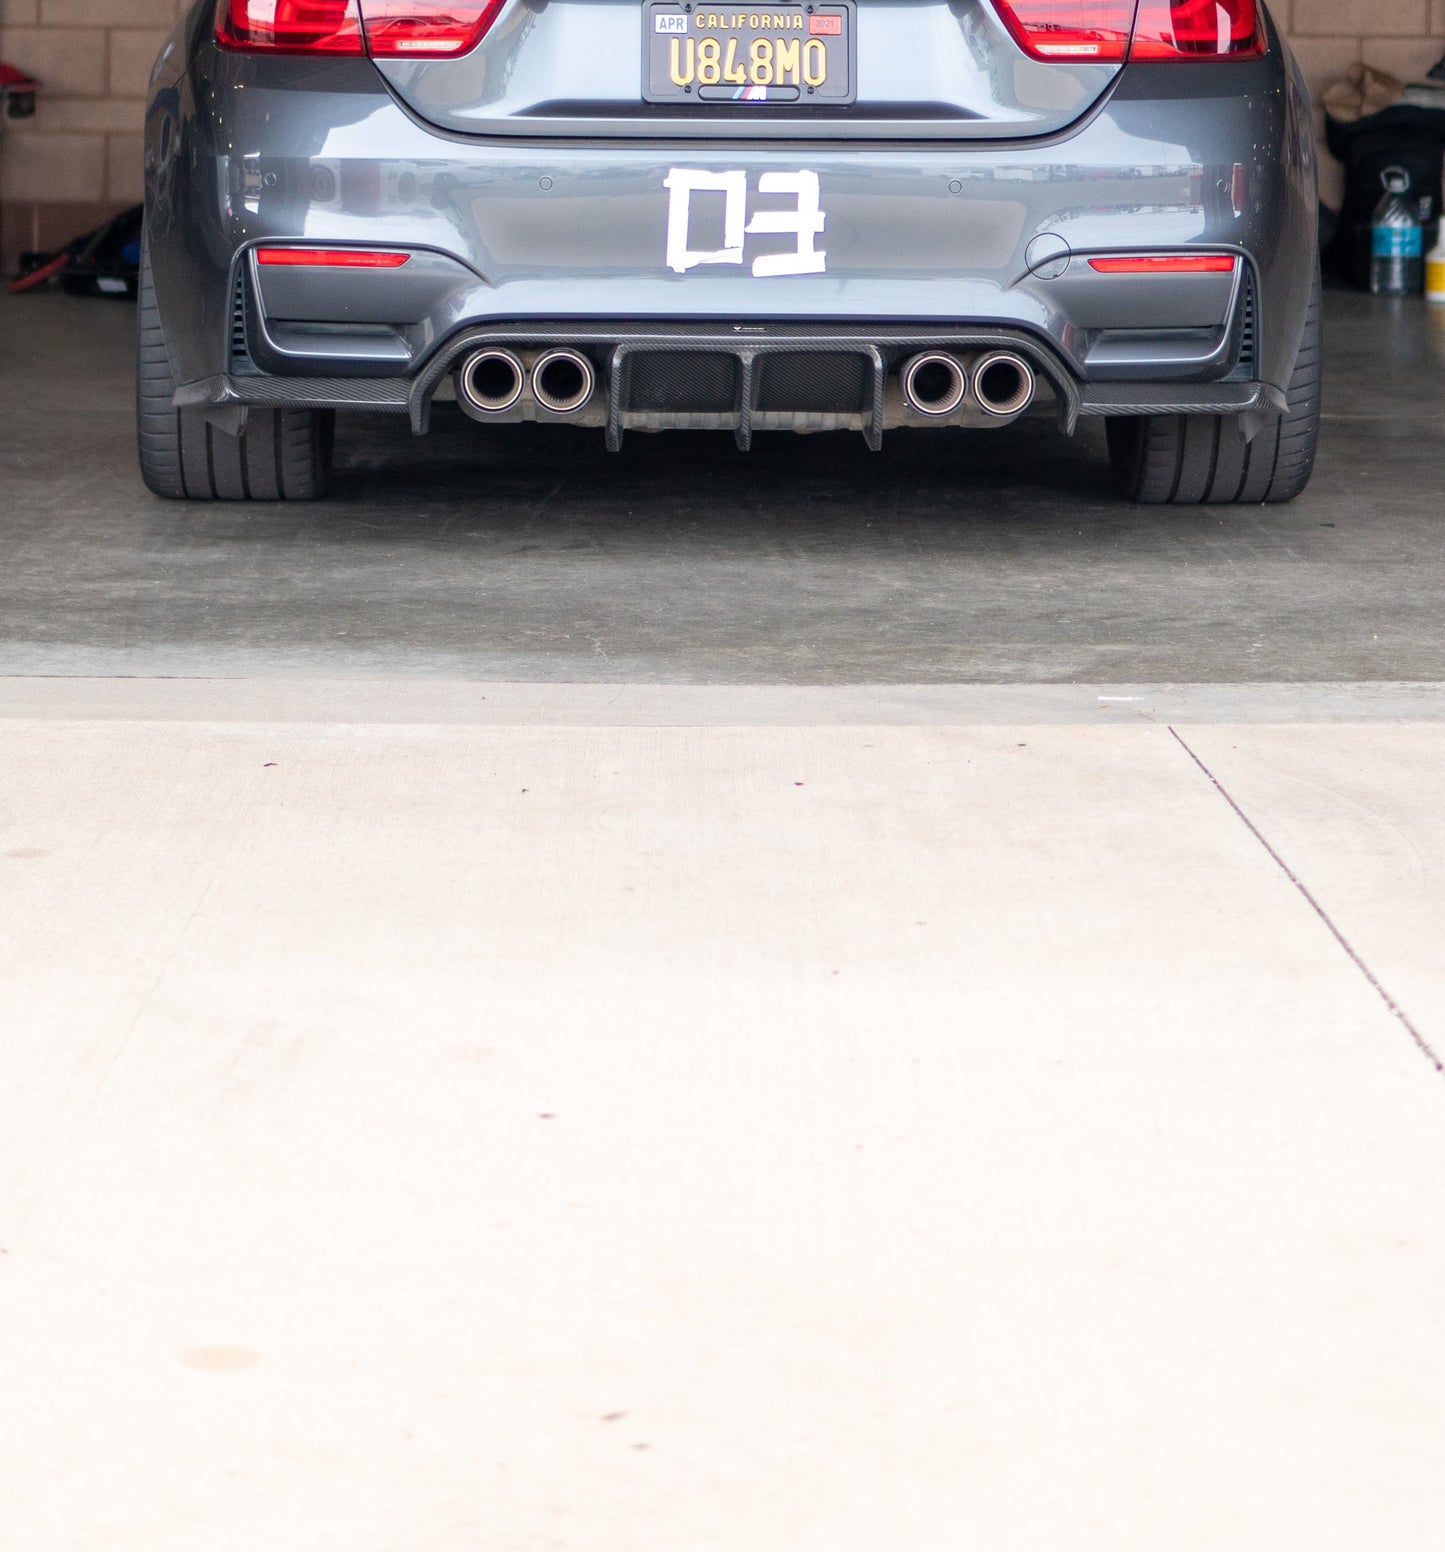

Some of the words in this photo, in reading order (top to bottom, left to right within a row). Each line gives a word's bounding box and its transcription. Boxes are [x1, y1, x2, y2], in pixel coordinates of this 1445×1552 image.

[659, 17, 685, 31] APR
[695, 13, 803, 29] CALIFORNIA
[815, 19, 835, 28] 2021
[663, 168, 827, 277] 03
